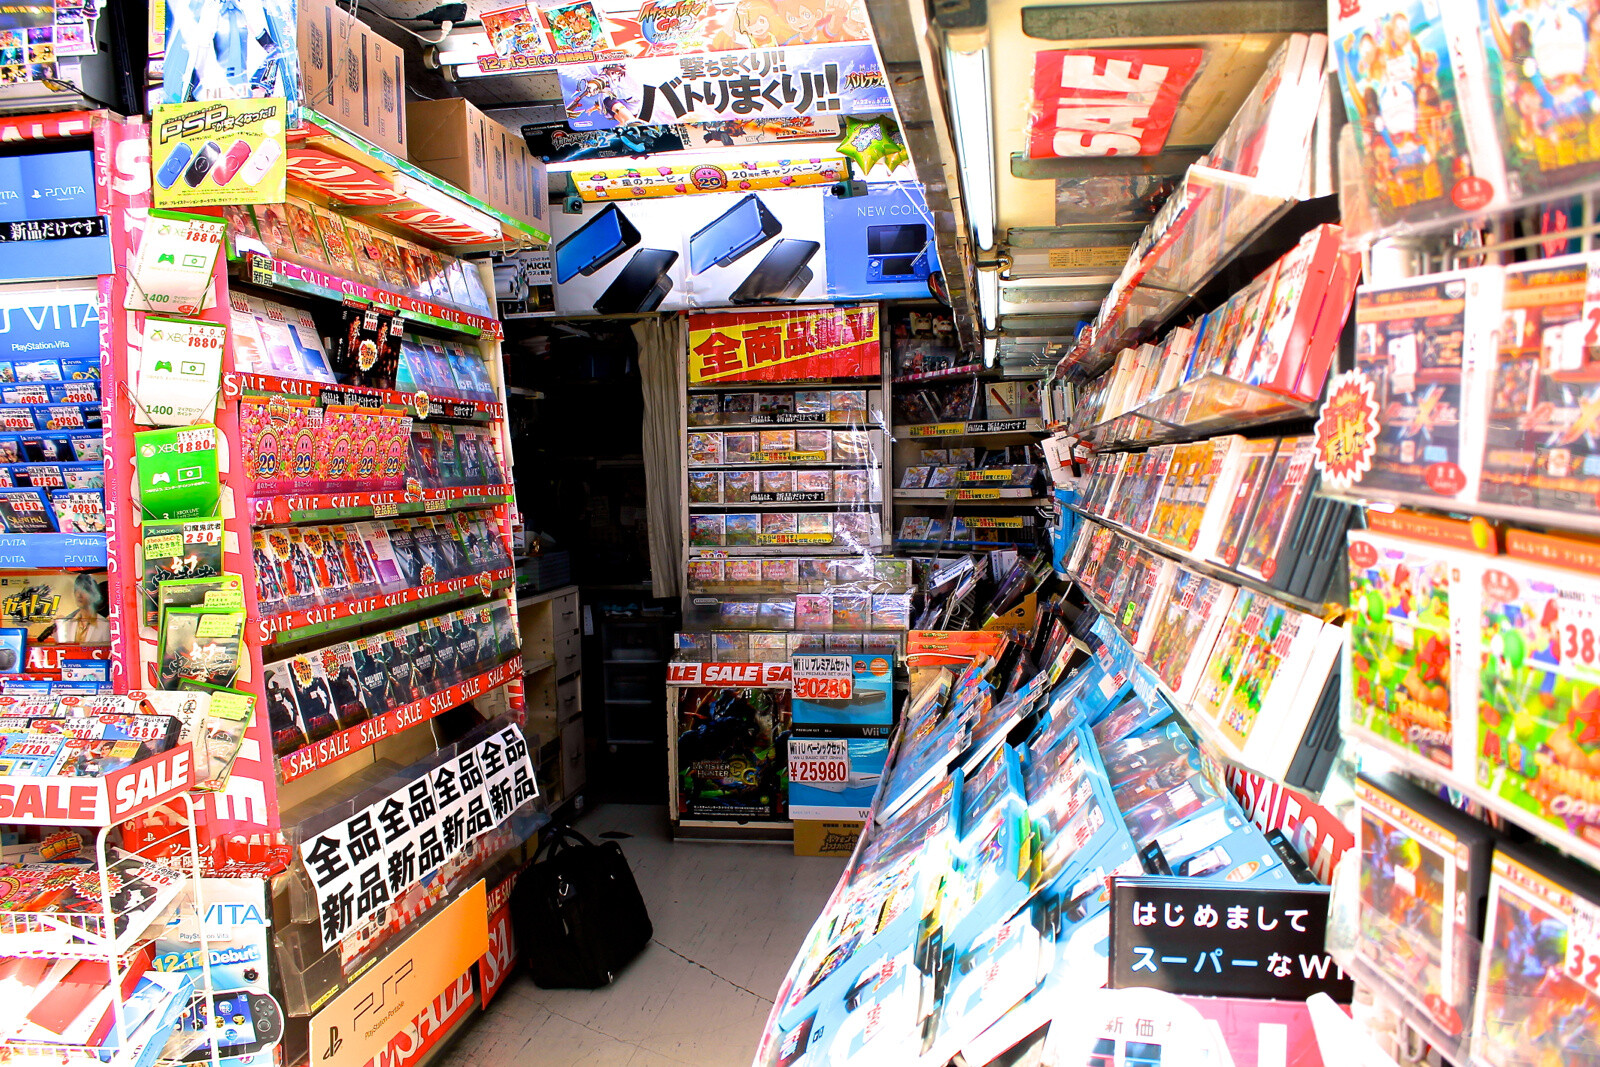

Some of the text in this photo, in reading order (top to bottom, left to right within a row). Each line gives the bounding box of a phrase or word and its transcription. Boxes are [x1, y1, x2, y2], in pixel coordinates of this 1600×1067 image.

[638, 64, 841, 121] バトりまくり!!
[1053, 55, 1169, 157] SALE
[160, 105, 229, 145] PSP
[621, 176, 685, 187] 星のカービィ
[857, 205, 886, 217] NEW
[301, 269, 331, 289] SALE
[341, 281, 368, 299] SALE
[378, 291, 402, 309] SALE
[410, 300, 434, 317] SALE
[53, 416, 79, 426] 2980
[145, 404, 174, 416] 1400
[72, 504, 98, 514] 4980
[287, 497, 319, 512] SALE
[331, 495, 360, 508] SALE
[370, 493, 394, 505] SALE
[259, 615, 292, 641] SALE
[306, 607, 337, 625] SALE
[348, 599, 376, 615] SALE
[384, 592, 408, 607] SALE
[417, 584, 439, 599] SALE
[703, 665, 759, 682] SALE
[319, 733, 351, 762] SALE
[360, 717, 388, 744] SALE
[396, 702, 423, 728] SALE
[429, 690, 453, 714] SALE
[460, 678, 480, 701] SALE
[487, 666, 504, 688] SALE
[131, 727, 159, 738] 580
[20, 744, 51, 755] 1780
[116, 749, 190, 813] SALE
[790, 761, 846, 781] ¥25980
[0, 784, 98, 819] SALE
[1131, 901, 1309, 932] はじめまして
[353, 958, 413, 1032] PSP
